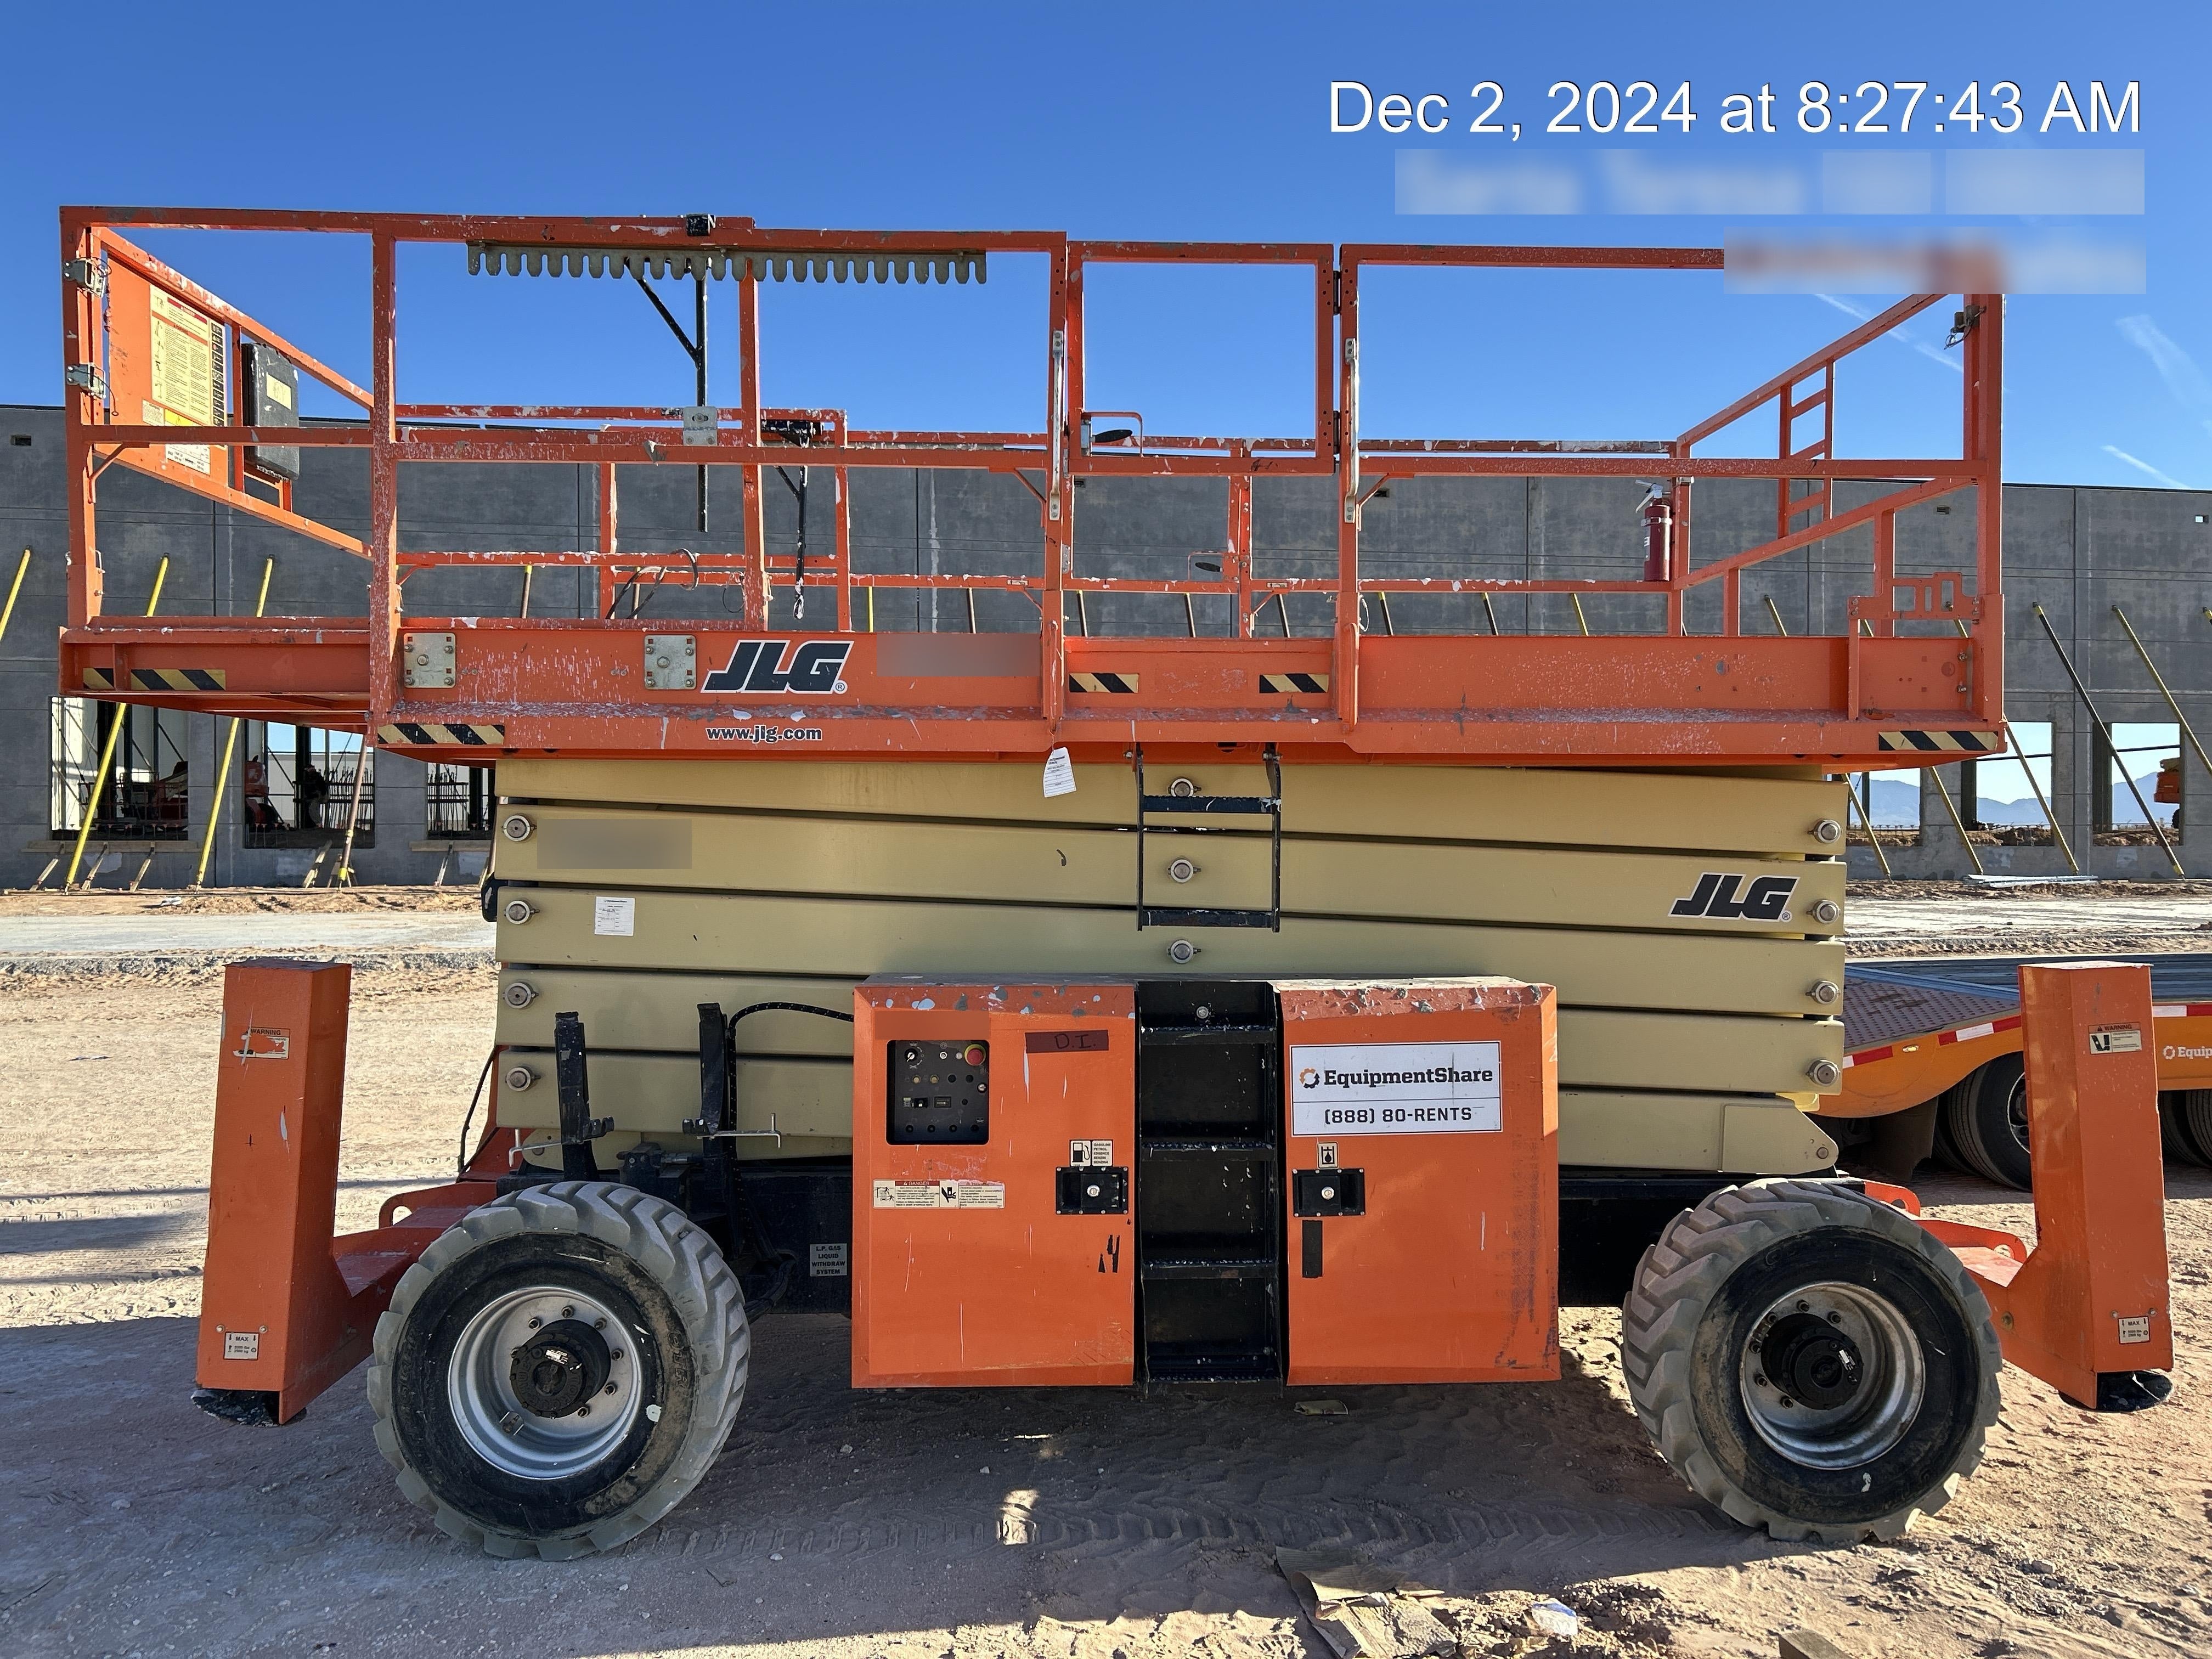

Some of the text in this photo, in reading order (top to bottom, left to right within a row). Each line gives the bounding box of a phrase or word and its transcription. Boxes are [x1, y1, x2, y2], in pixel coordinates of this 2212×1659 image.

[706, 725, 823, 743] www.jlg.com
[1324, 1067, 1493, 1088] EquipmentShare
[1325, 1107, 1472, 1125] (888) 80-RENTS
